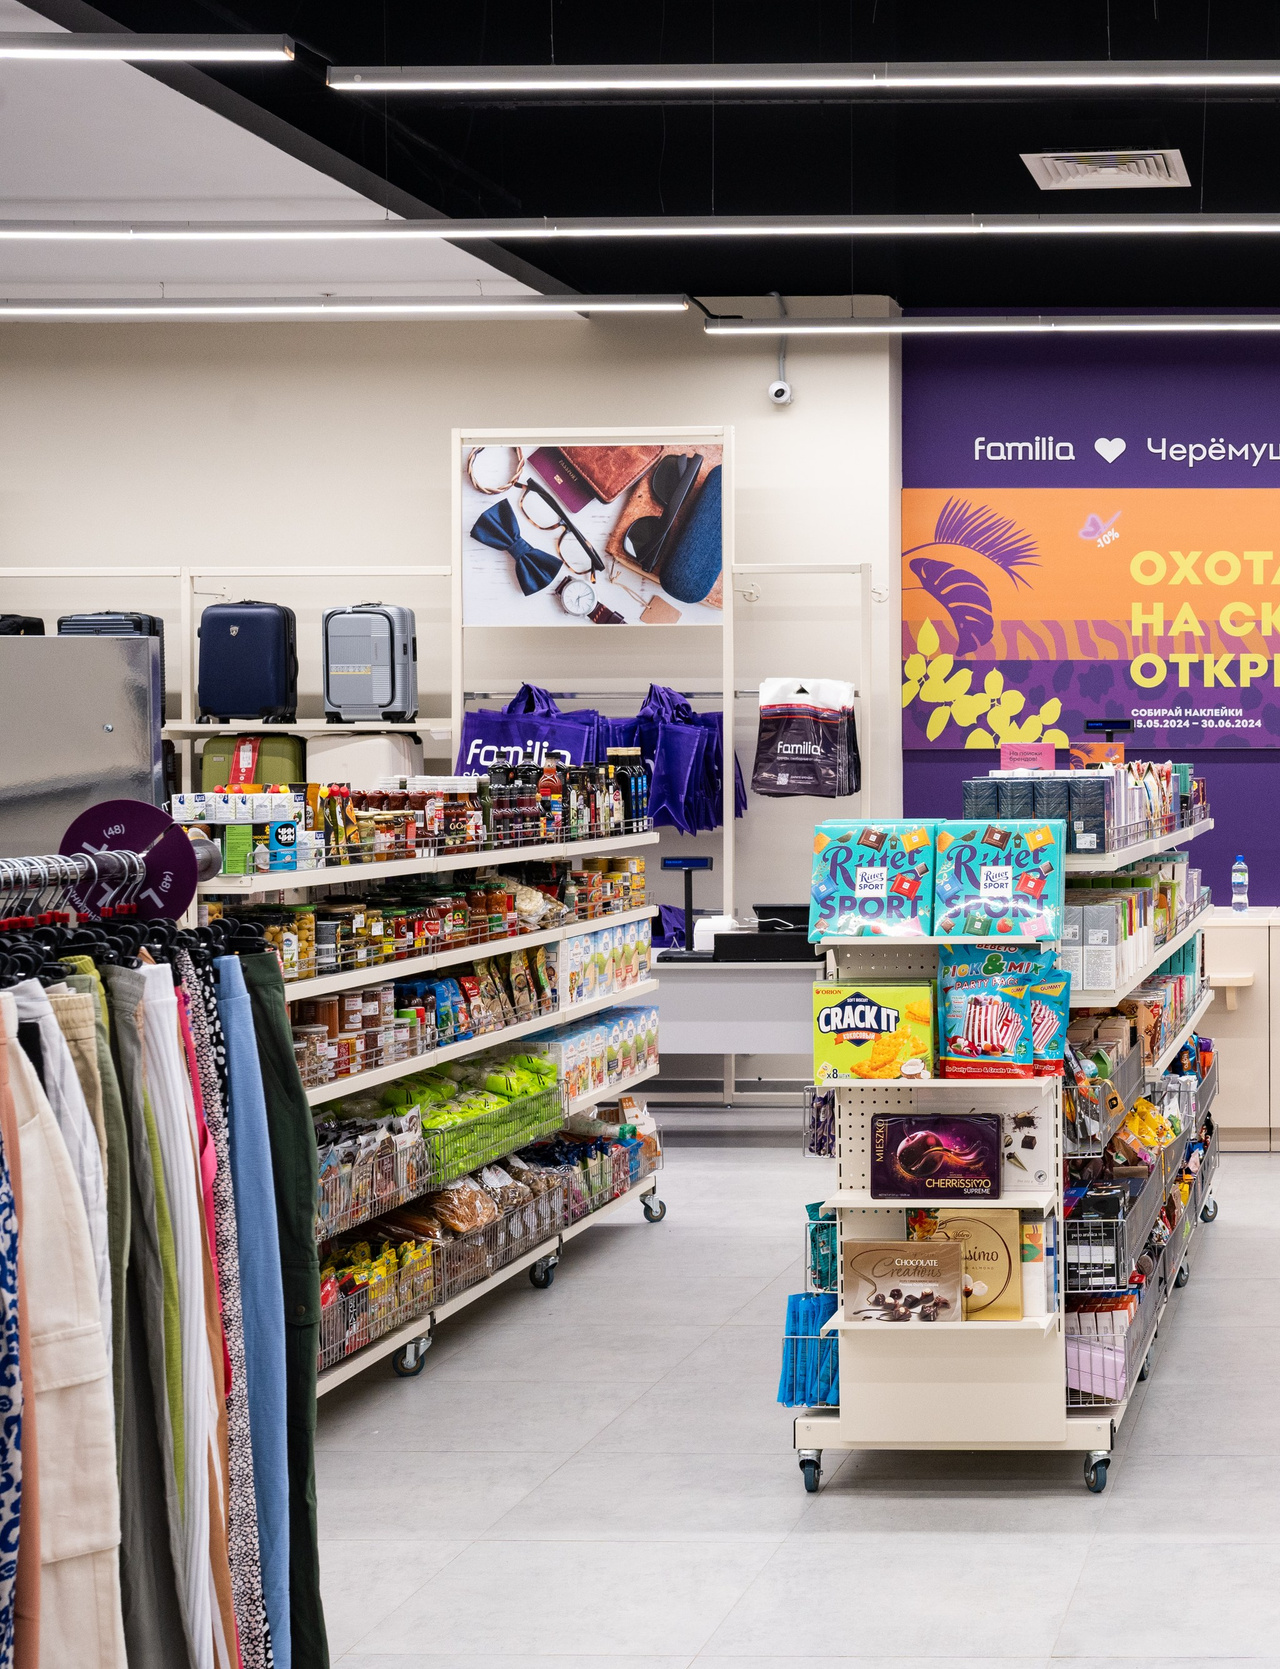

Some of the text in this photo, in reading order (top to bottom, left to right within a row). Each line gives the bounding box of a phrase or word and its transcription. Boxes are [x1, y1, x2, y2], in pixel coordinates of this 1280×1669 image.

[974, 436, 1075, 461] familia
[1131, 602, 1205, 637] НА
[1131, 706, 1243, 718] СОБИРАЙ НАКЛЕЙКИ
[1201, 719, 1262, 729] 30.06.2024
[777, 740, 821, 756] familia
[859, 871, 885, 883] Ritter
[983, 870, 1009, 883] Ritter
[983, 882, 1009, 890] SPORT
[819, 895, 924, 919] SPORT
[944, 894, 1049, 919] SPORT
[942, 962, 981, 978] PICK
[1007, 962, 1044, 975] MIX
[955, 979, 989, 990] PARTY
[1040, 984, 1061, 992] GUMMY
[818, 1005, 899, 1033] CRACK IT
[875, 1119, 886, 1162] MIESZKO
[871, 1256, 943, 1279] Creations
[895, 1258, 938, 1267] CHOCOLATE
